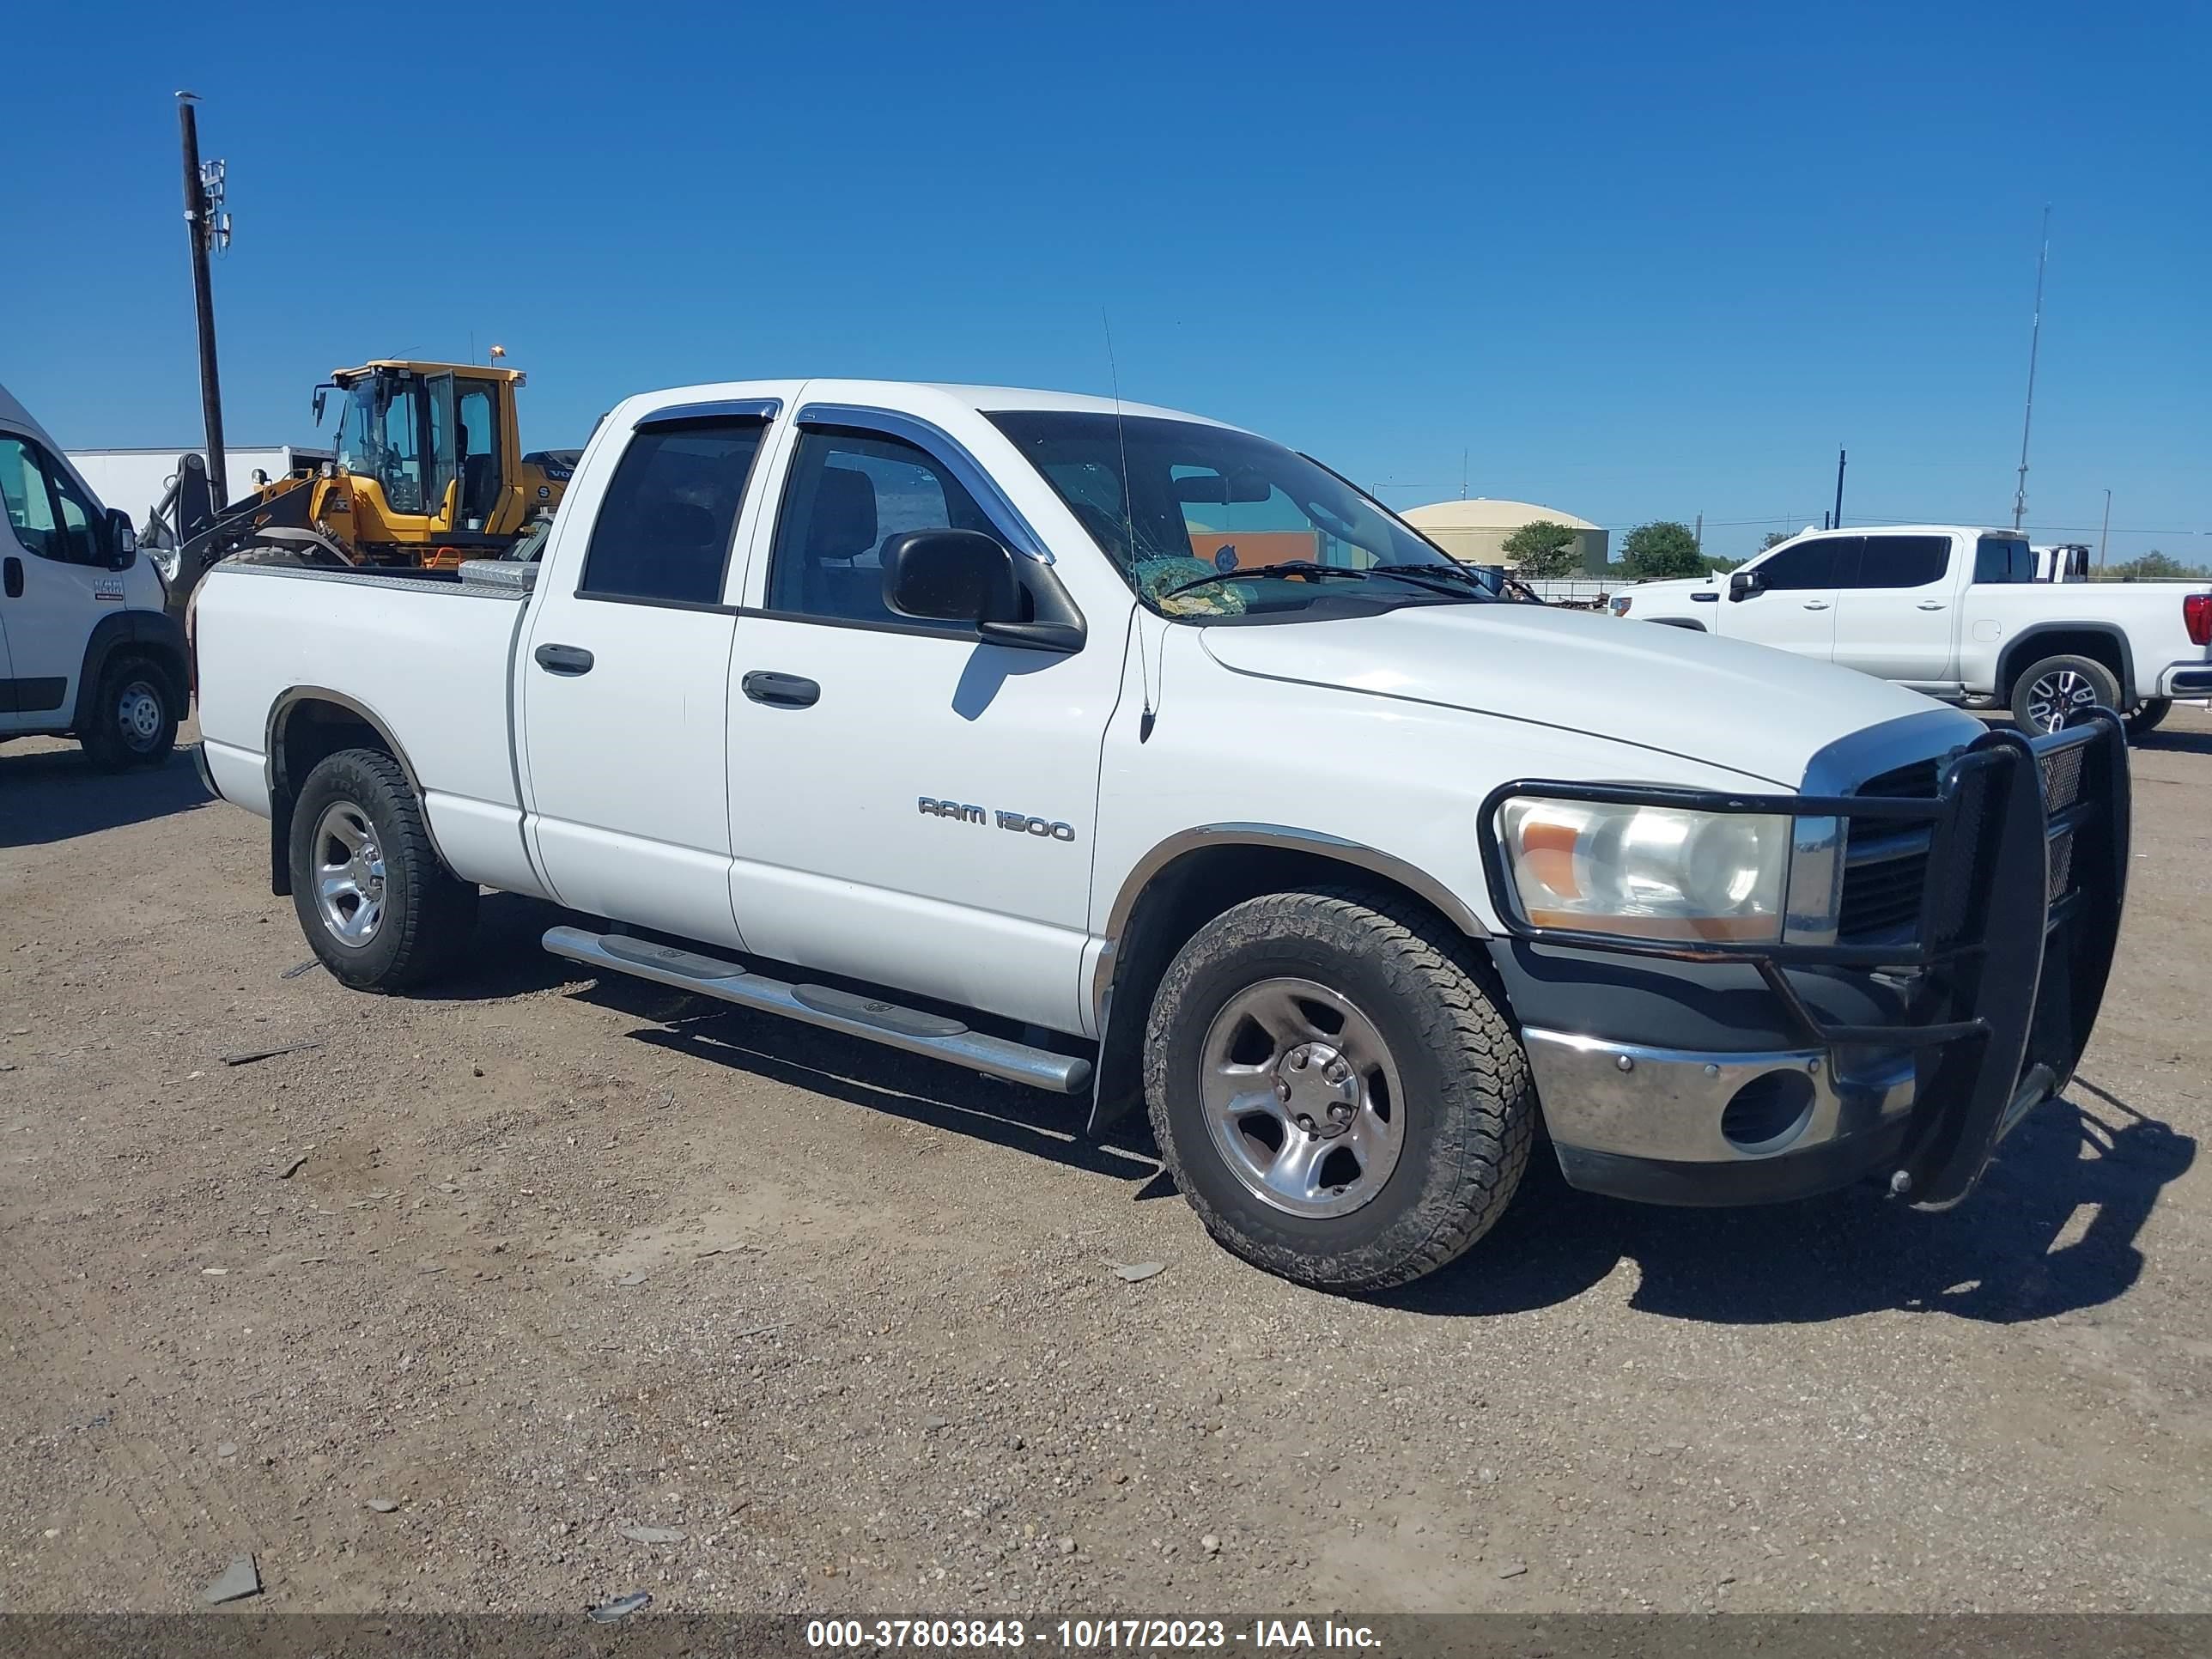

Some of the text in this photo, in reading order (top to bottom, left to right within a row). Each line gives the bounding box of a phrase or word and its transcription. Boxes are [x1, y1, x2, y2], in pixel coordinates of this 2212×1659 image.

[550, 470, 573, 478] VO
[918, 796, 1075, 842] RAM 1500
